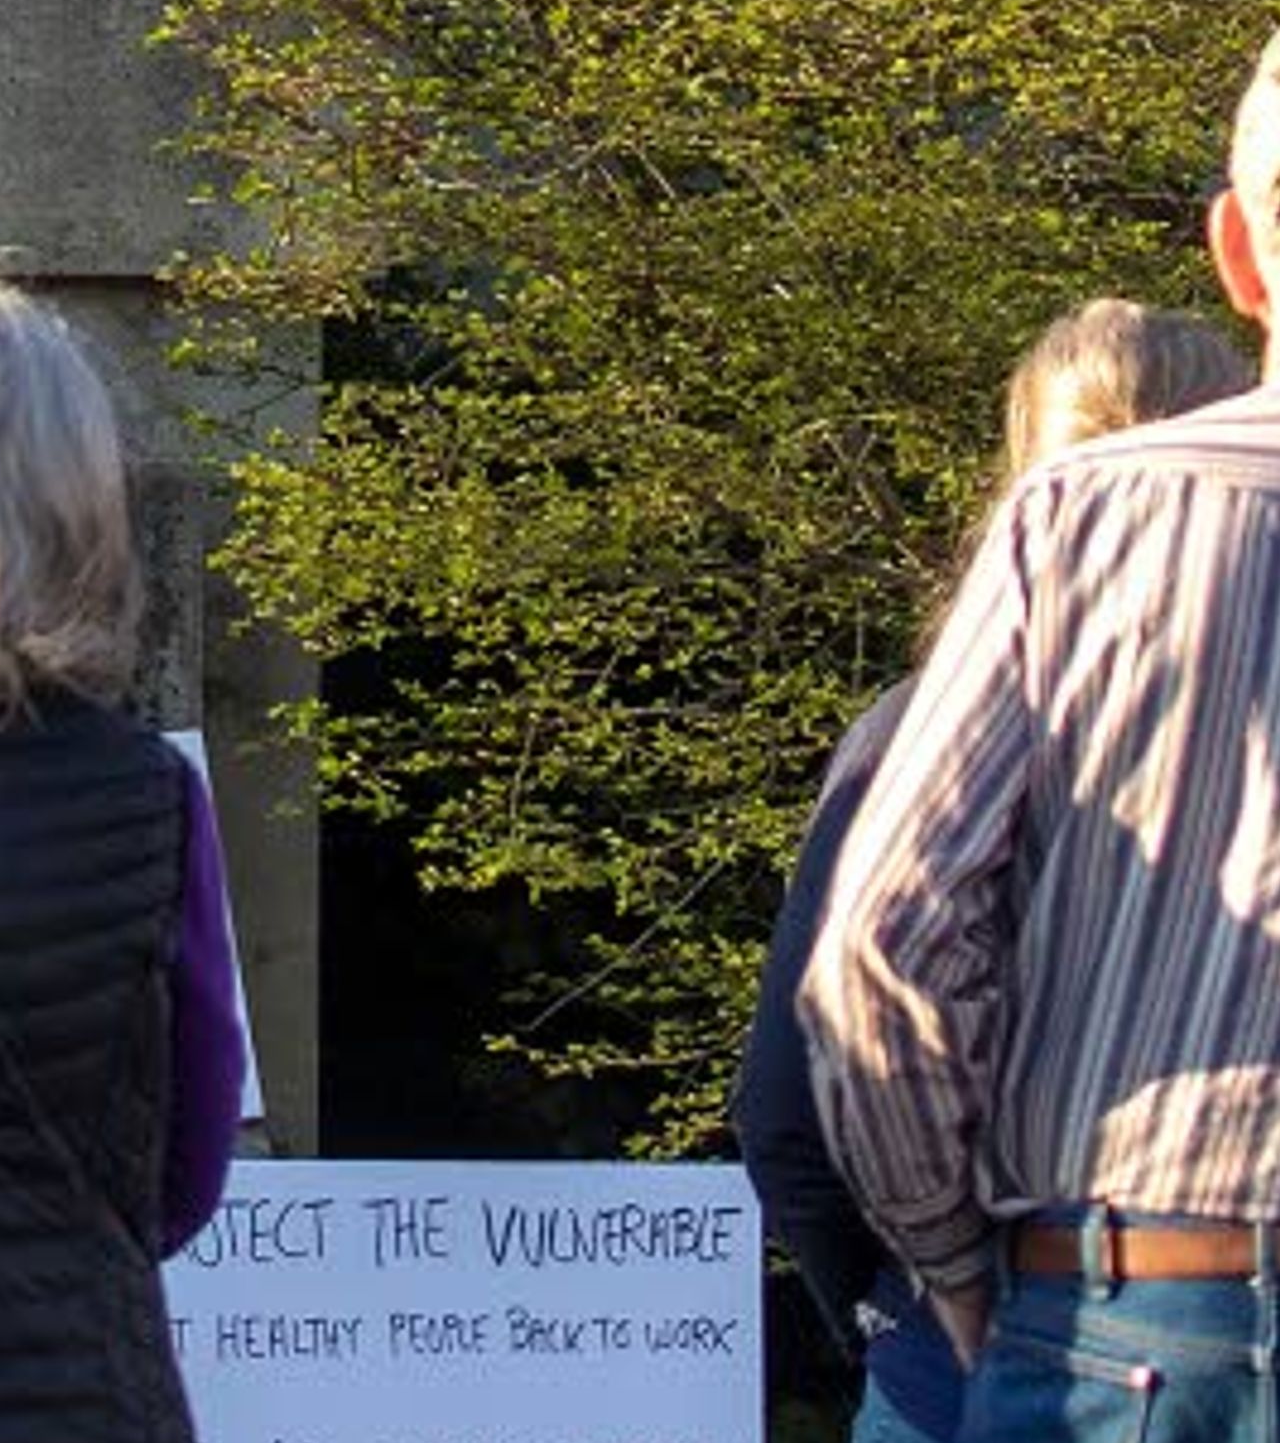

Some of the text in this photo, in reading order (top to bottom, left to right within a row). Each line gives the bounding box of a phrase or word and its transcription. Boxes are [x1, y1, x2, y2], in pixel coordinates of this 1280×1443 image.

[186, 1198, 333, 1267] OTECT
[362, 1198, 449, 1267] THE
[216, 1314, 362, 1360] HEALTHY
[389, 1313, 488, 1357] PEOPLE
[591, 1317, 631, 1350] TO
[645, 1317, 739, 1355] WORK
